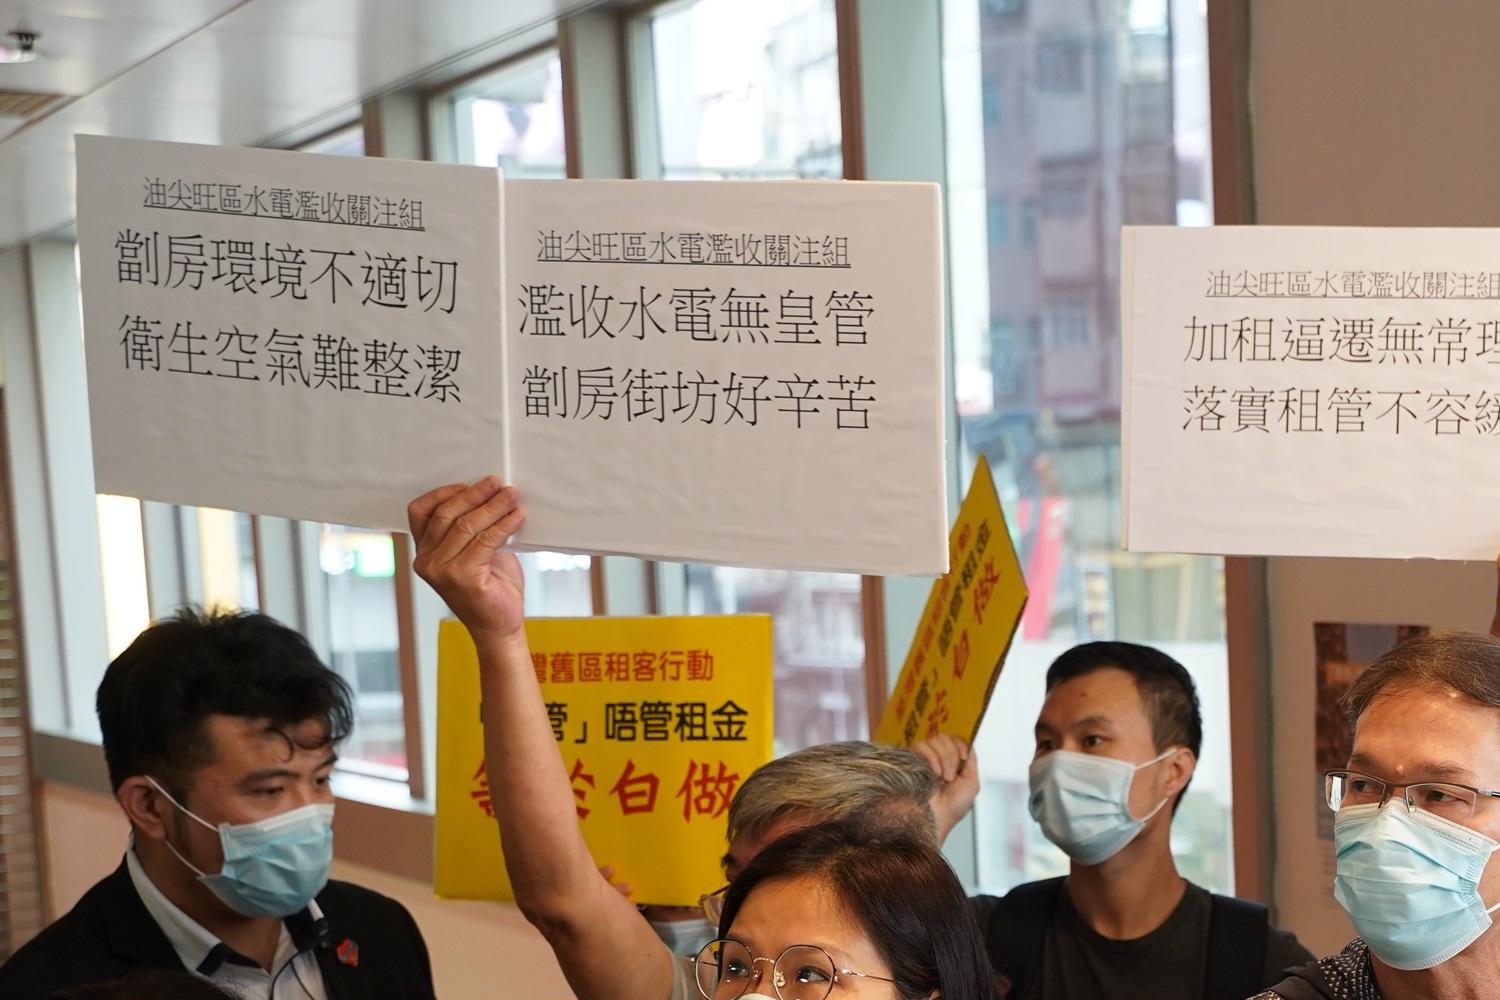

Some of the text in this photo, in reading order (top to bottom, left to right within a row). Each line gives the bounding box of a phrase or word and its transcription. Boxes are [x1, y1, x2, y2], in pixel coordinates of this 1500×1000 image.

[142, 177, 426, 230] 油尖旺區水電濫收關注組
[115, 231, 459, 314] 劏房環境不適切
[536, 230, 852, 269] 油尖旺區水電濫收關注組
[518, 285, 875, 347] 濫收水電無皇管
[119, 315, 462, 403] 衛生空氣難整潔
[522, 365, 876, 430] 劏房街坊好辛苦
